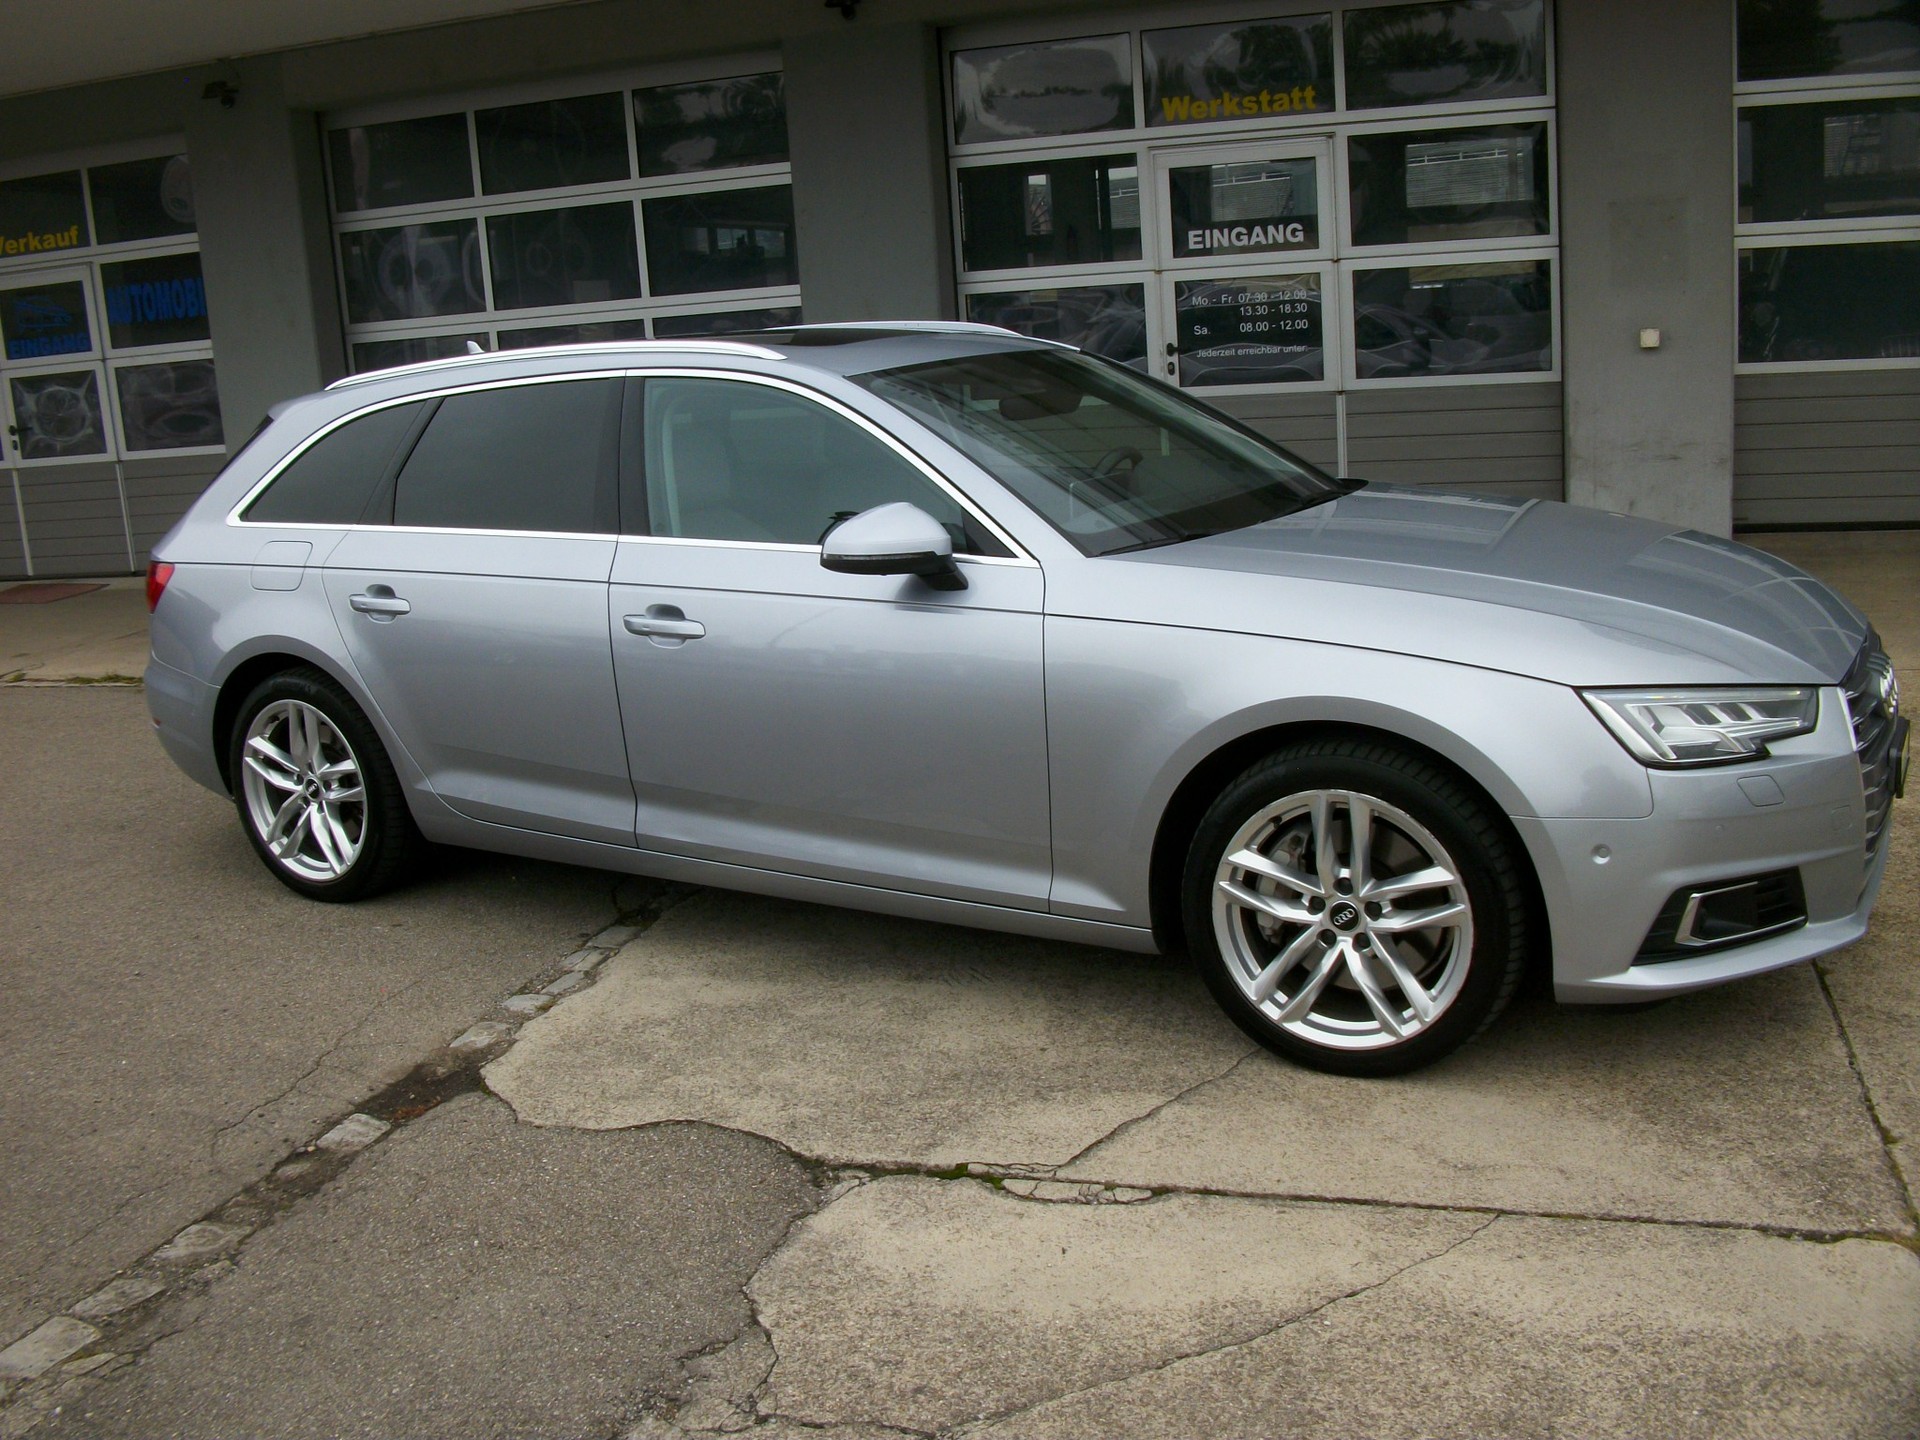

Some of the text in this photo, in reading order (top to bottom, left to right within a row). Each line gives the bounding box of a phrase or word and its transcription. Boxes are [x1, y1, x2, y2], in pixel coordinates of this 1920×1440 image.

[1161, 85, 1316, 122] Werkstatt
[1188, 223, 1304, 249] EINGANG
[1221, 294, 1235, 304] Fr.
[1279, 290, 1307, 301] 12.00
[1240, 305, 1268, 316] 13.30
[1279, 302, 1308, 314] 18.30
[1193, 325, 1211, 336] Sa.
[1240, 321, 1269, 333] 08.00
[1280, 319, 1309, 330] 12.00
[8, 331, 91, 359] EINGANG
[1196, 350, 1236, 358] Jederzeit
[1237, 346, 1281, 355] erreichbar
